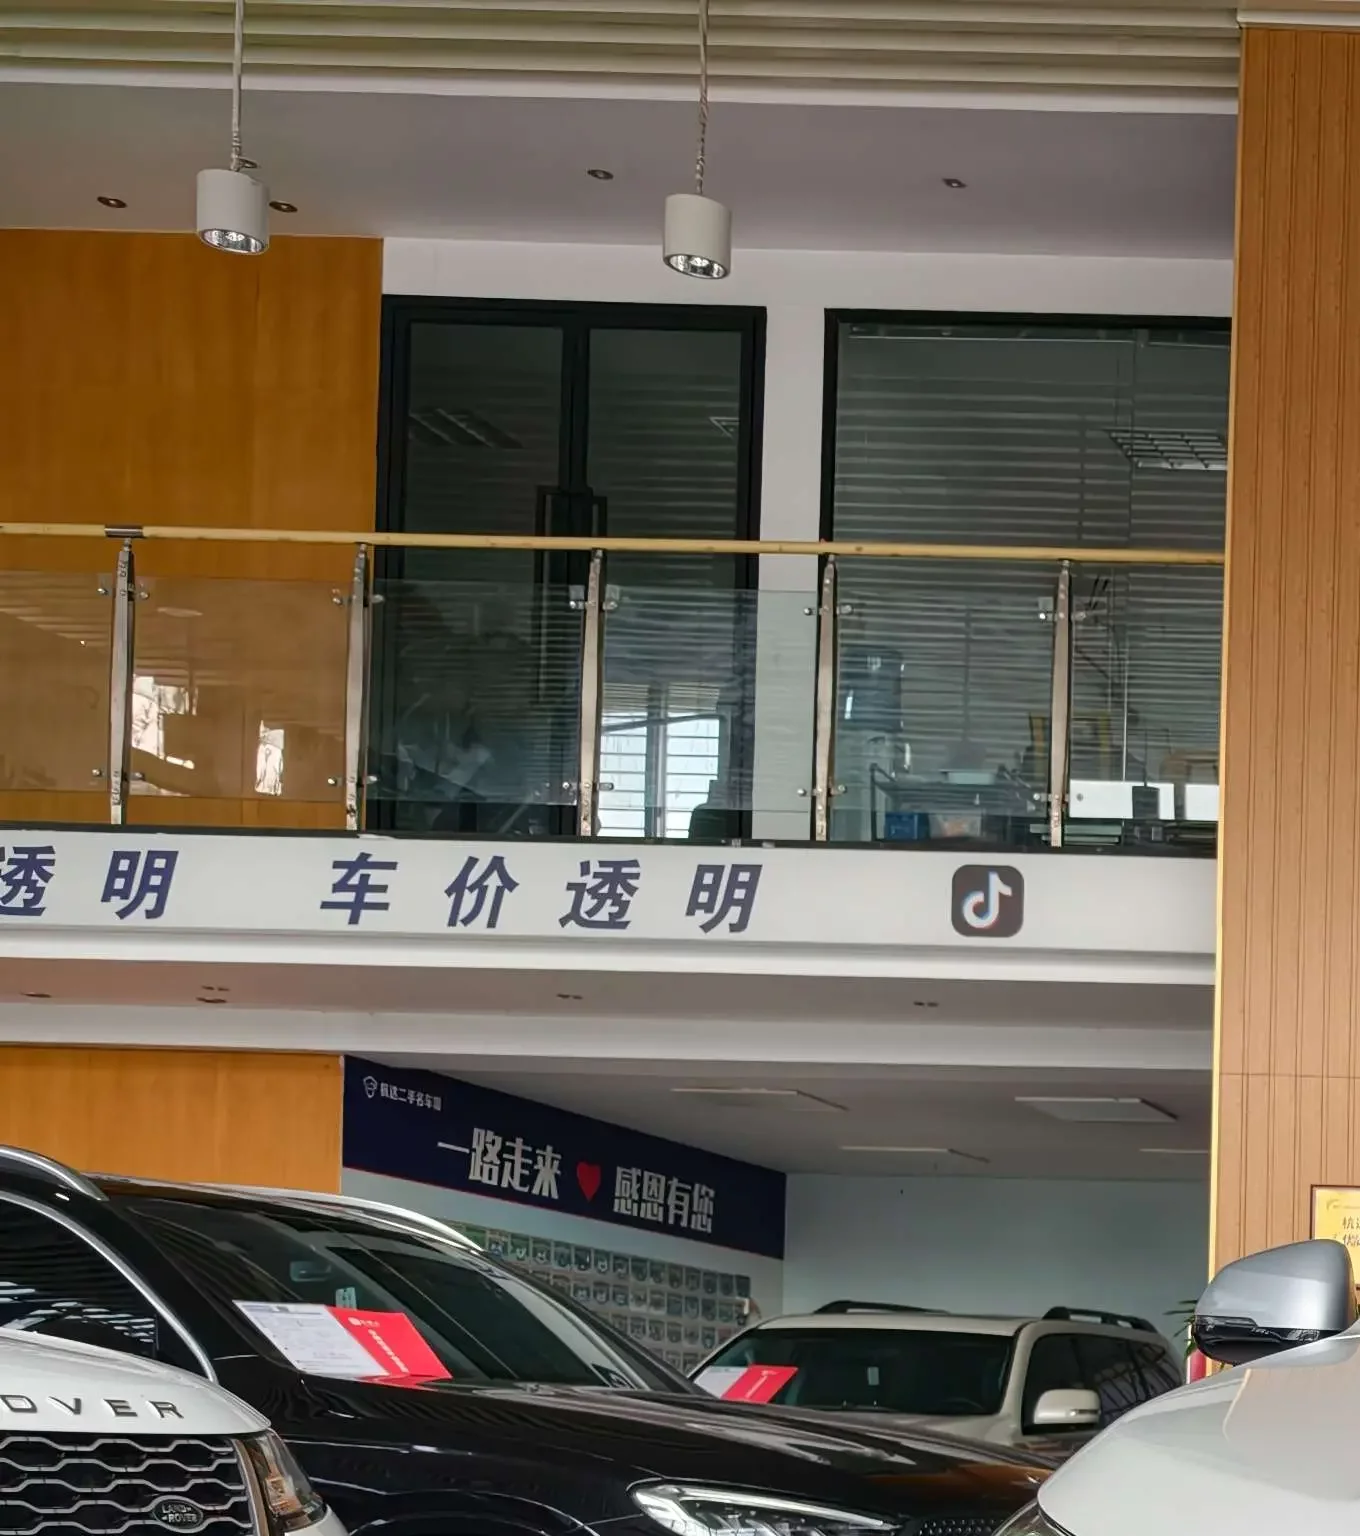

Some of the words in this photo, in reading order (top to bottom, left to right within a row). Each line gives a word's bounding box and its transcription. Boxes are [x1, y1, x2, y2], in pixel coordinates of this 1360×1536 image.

[0, 845, 179, 920] 透明
[320, 851, 763, 934] 车价透明
[437, 1127, 562, 1200] 一路走来
[612, 1165, 716, 1234] 感恩有您
[168, 1512, 198, 1523] ROVER
